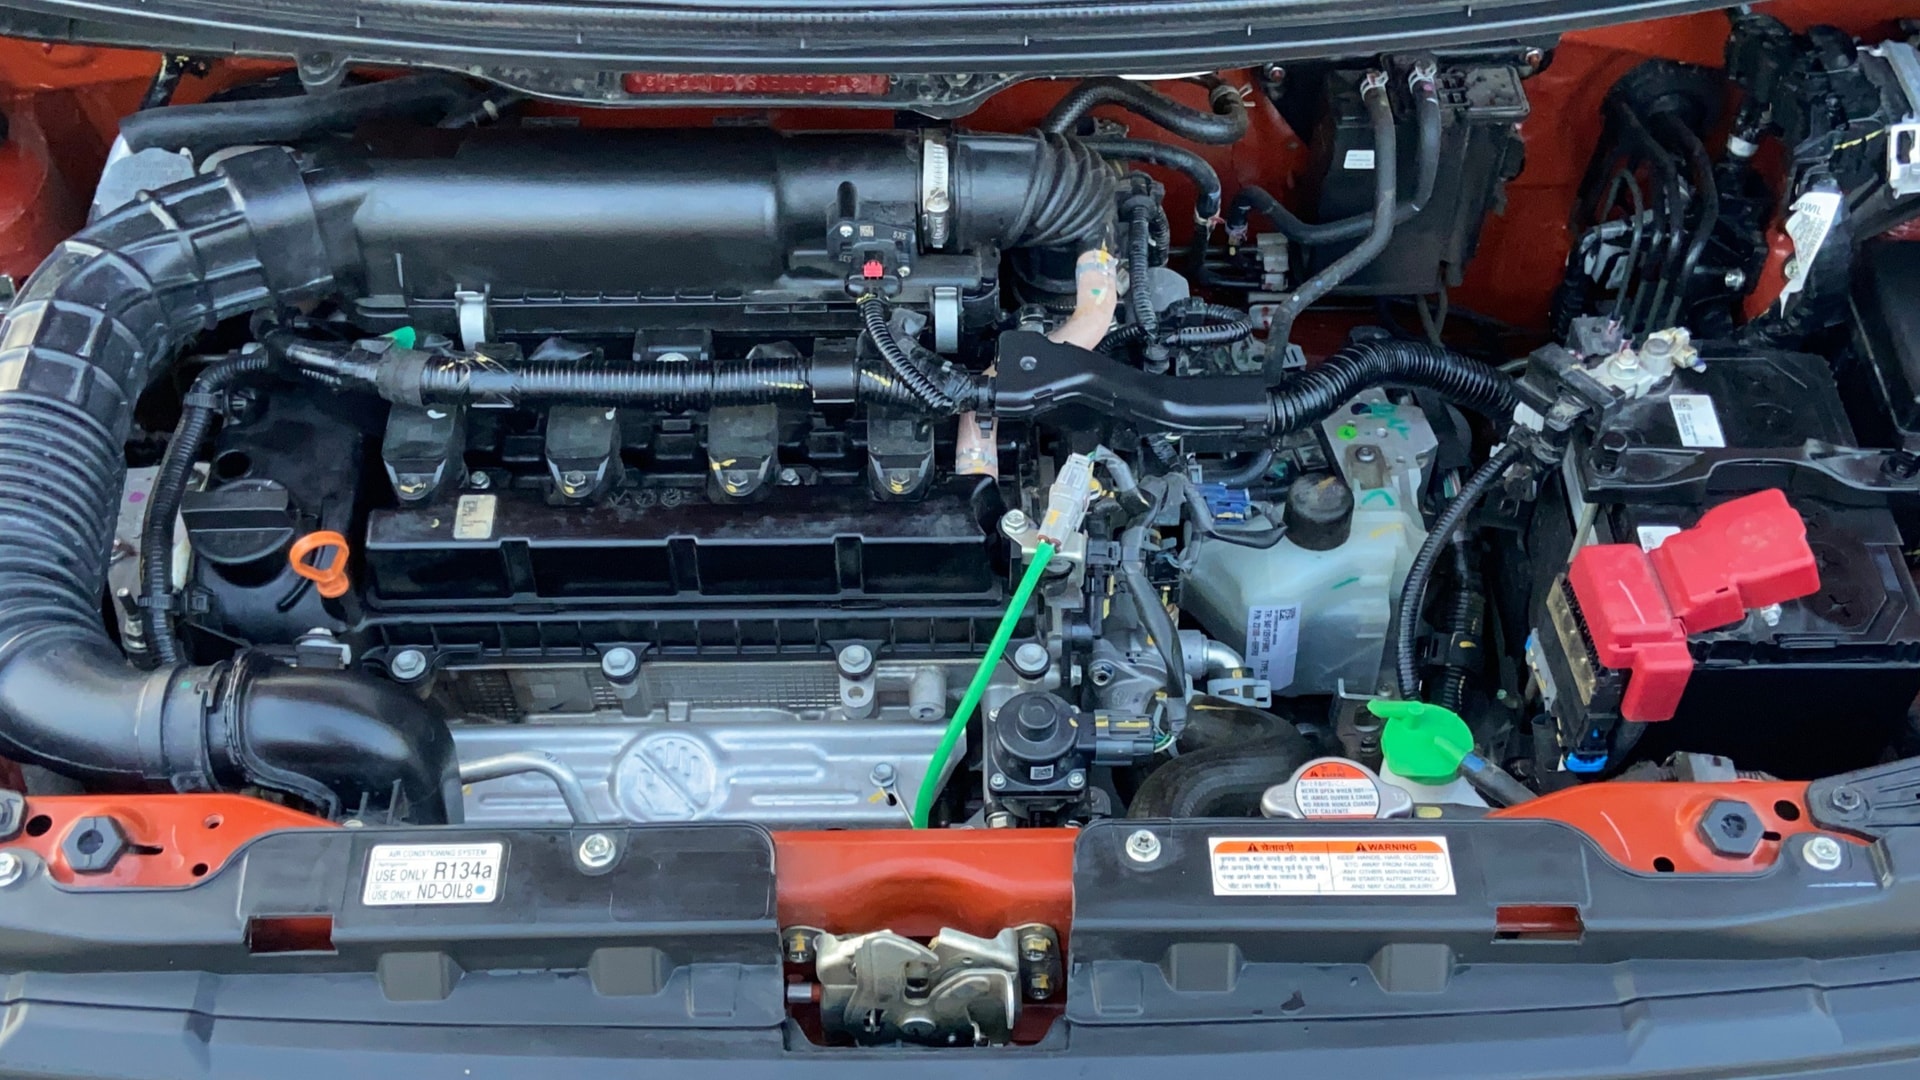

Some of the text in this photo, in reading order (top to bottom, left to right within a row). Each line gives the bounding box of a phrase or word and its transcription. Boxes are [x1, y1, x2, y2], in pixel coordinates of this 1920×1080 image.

[389, 850, 401, 858] AIR
[403, 849, 456, 858] CONDITIONING
[1368, 843, 1417, 851] WARNING
[375, 861, 493, 881] USE ONLY R134a
[371, 883, 473, 900] USE ONLY ND-OIL8
